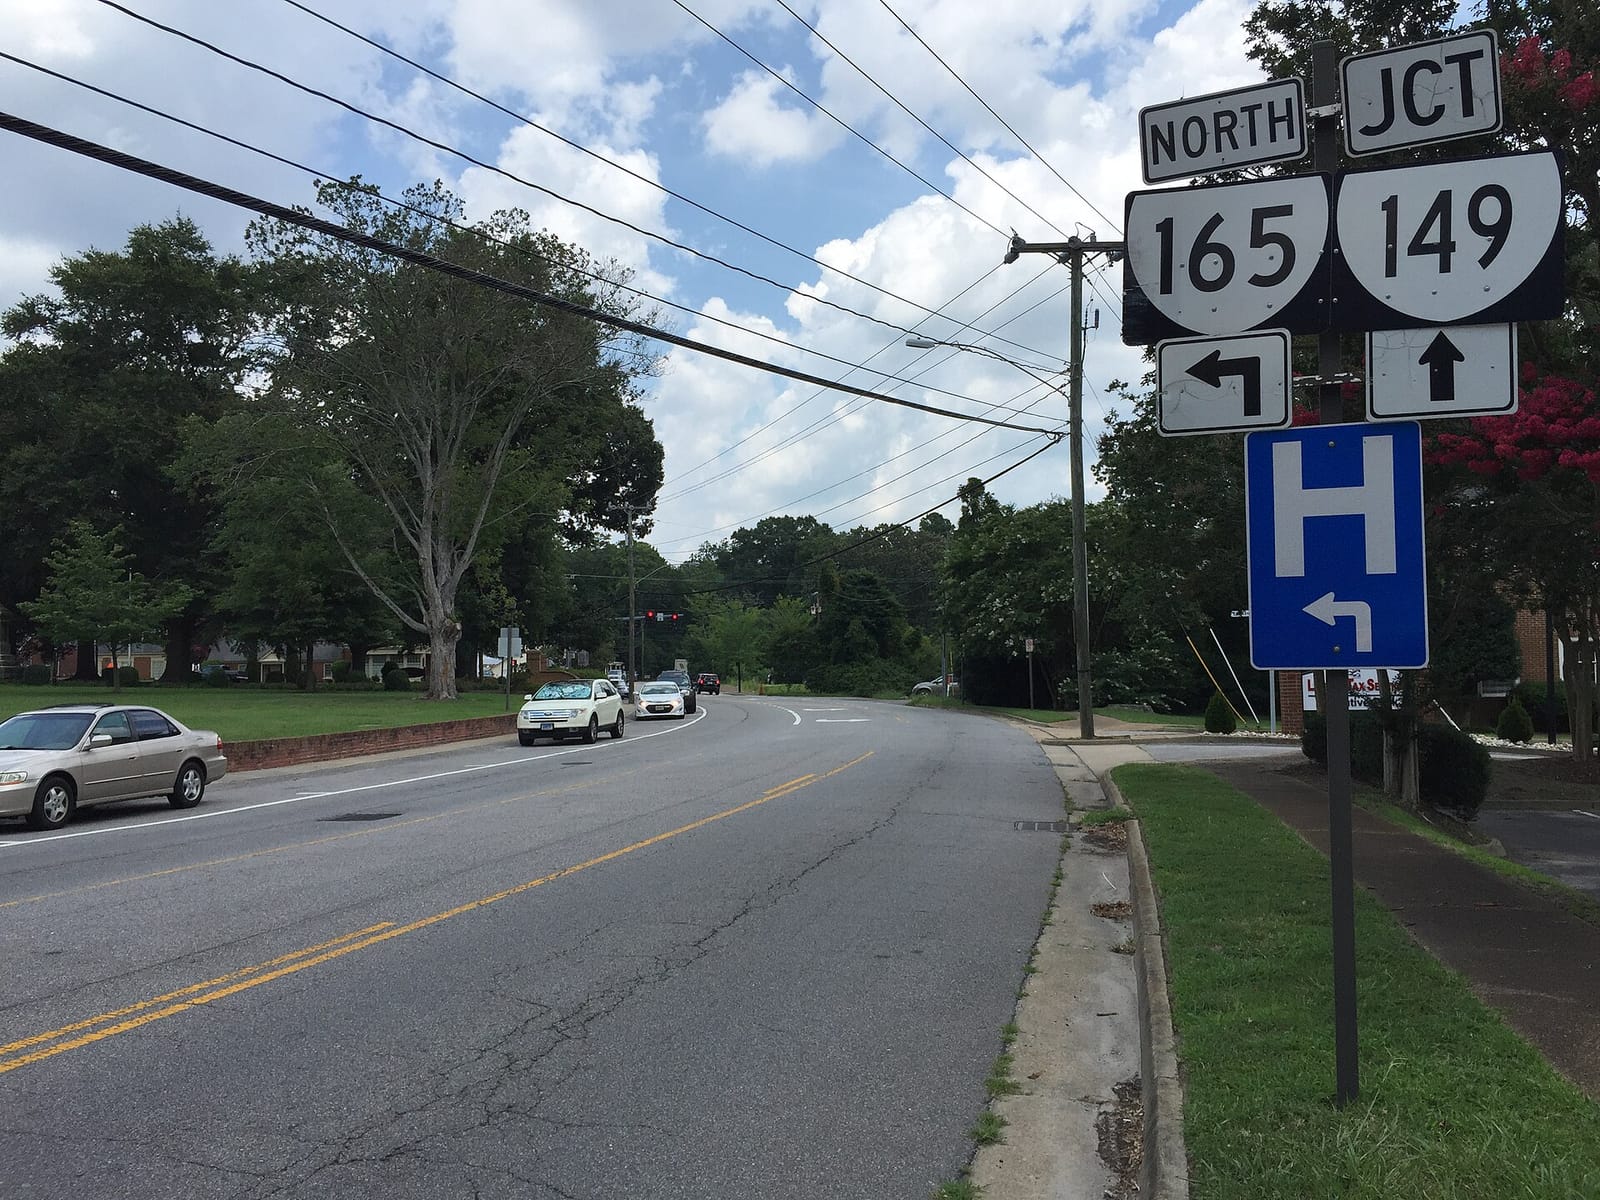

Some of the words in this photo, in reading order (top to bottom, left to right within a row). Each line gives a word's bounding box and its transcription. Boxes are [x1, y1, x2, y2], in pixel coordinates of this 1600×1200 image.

[1150, 97, 1296, 166] NORTH
[1358, 49, 1485, 137] JCT
[1155, 203, 1297, 295] 165
[1380, 183, 1513, 279] 149
[1272, 434, 1397, 578] H
